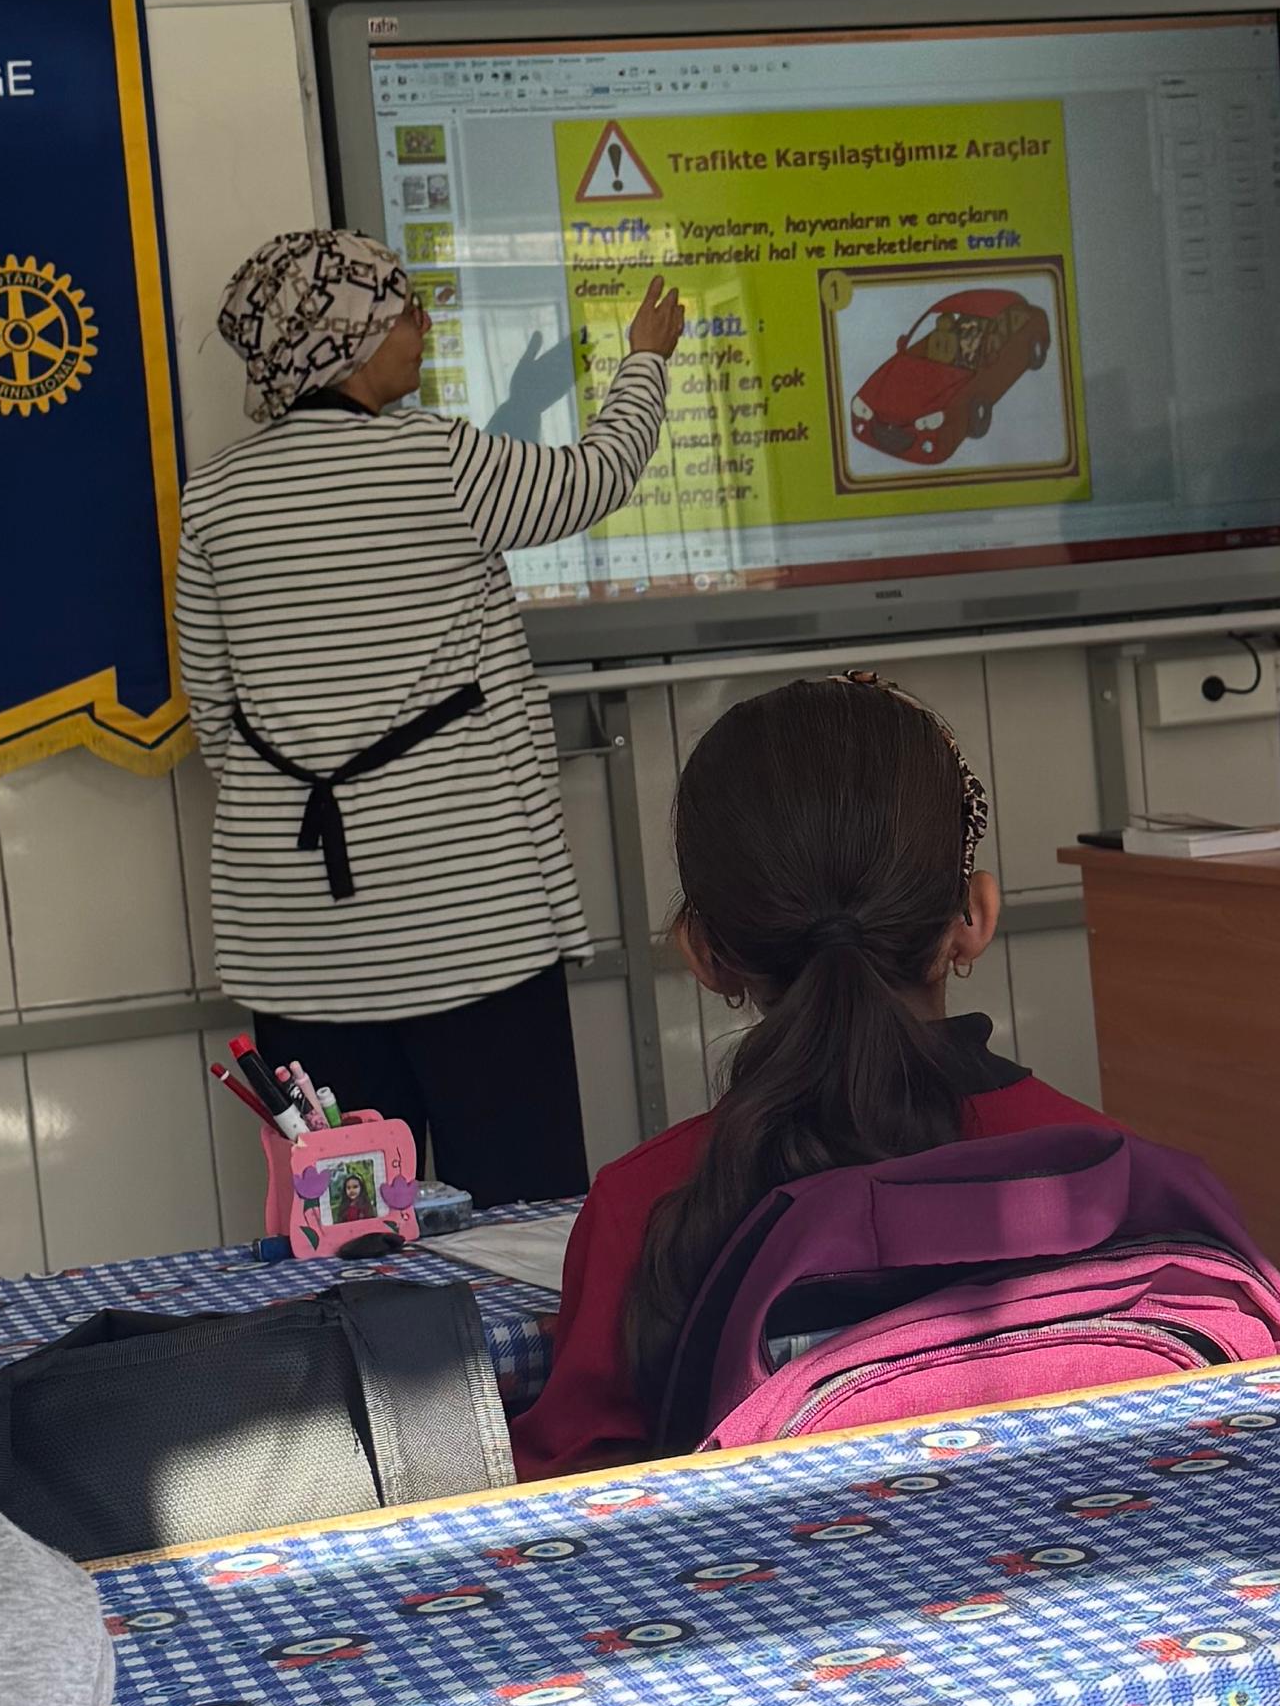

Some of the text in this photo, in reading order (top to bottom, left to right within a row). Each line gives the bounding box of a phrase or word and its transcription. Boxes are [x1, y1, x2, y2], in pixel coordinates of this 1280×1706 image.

[668, 136, 1051, 174] Trafikte Karşılaştığımız Araçlar
[572, 218, 651, 243] Trafik
[680, 219, 774, 243] Yayaların,
[785, 210, 891, 238] hayvanların
[898, 212, 919, 228] ve
[926, 205, 1008, 229] araçların
[572, 229, 1021, 275] karayolu üzerindeki hal ve hareketlerine trafik
[575, 279, 631, 298] denir.
[681, 368, 805, 394] dahil en çok
[728, 397, 769, 424] yeri
[671, 421, 809, 449] insan taşımak
[685, 455, 755, 478] edilmiş
